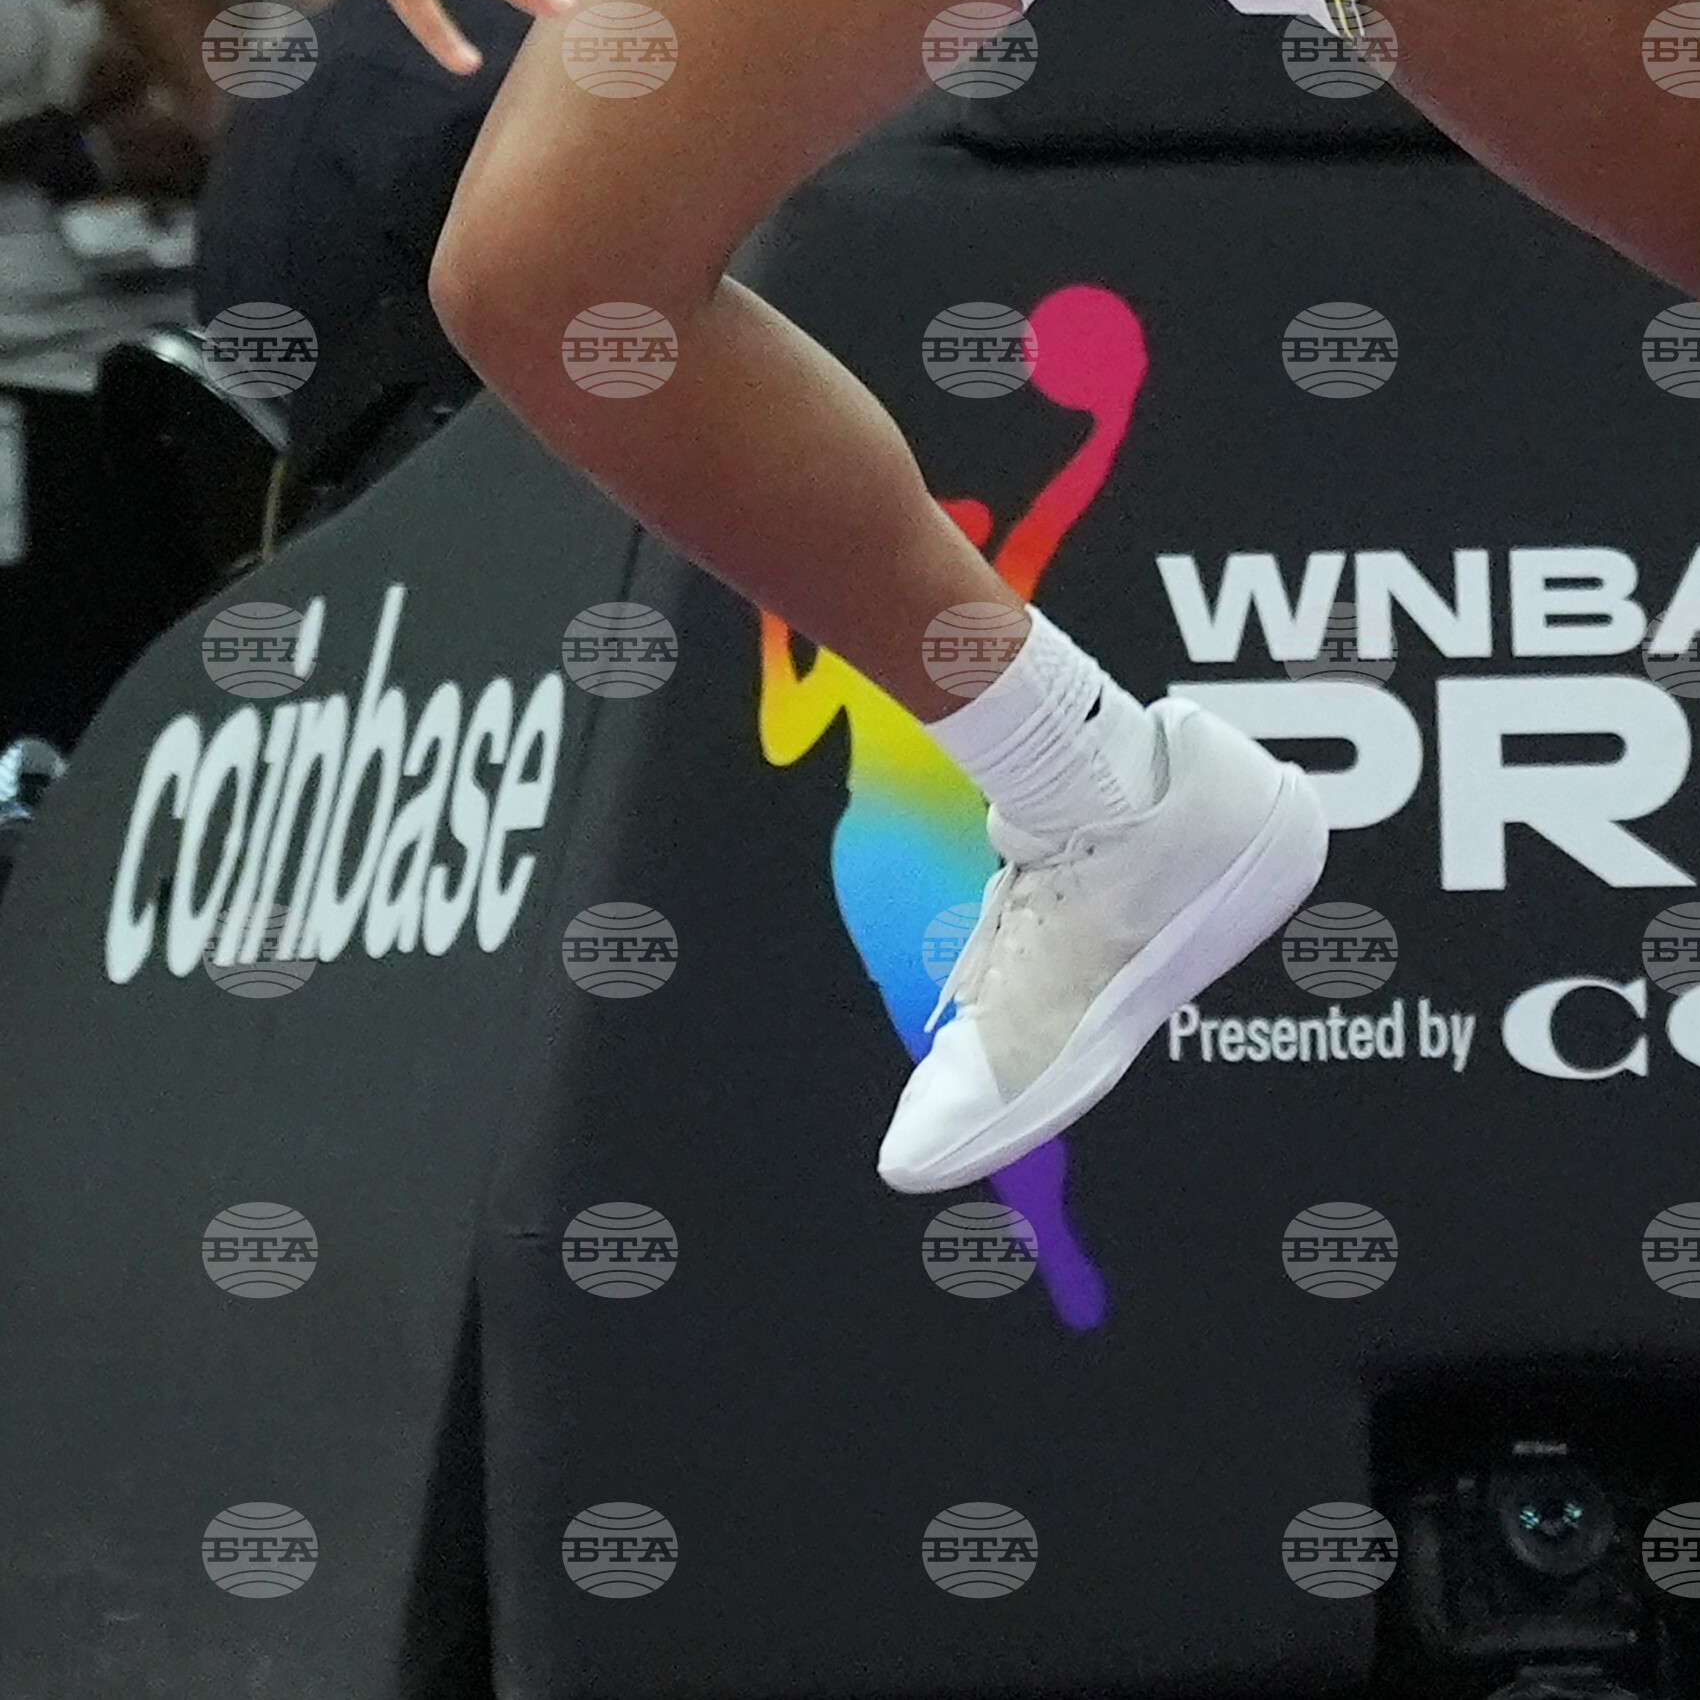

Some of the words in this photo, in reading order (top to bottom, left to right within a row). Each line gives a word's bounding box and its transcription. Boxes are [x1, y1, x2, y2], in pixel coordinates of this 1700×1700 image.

[105, 583, 565, 984] coinbase
[1168, 998, 1405, 1062] Presented
[1417, 997, 1476, 1073] by
